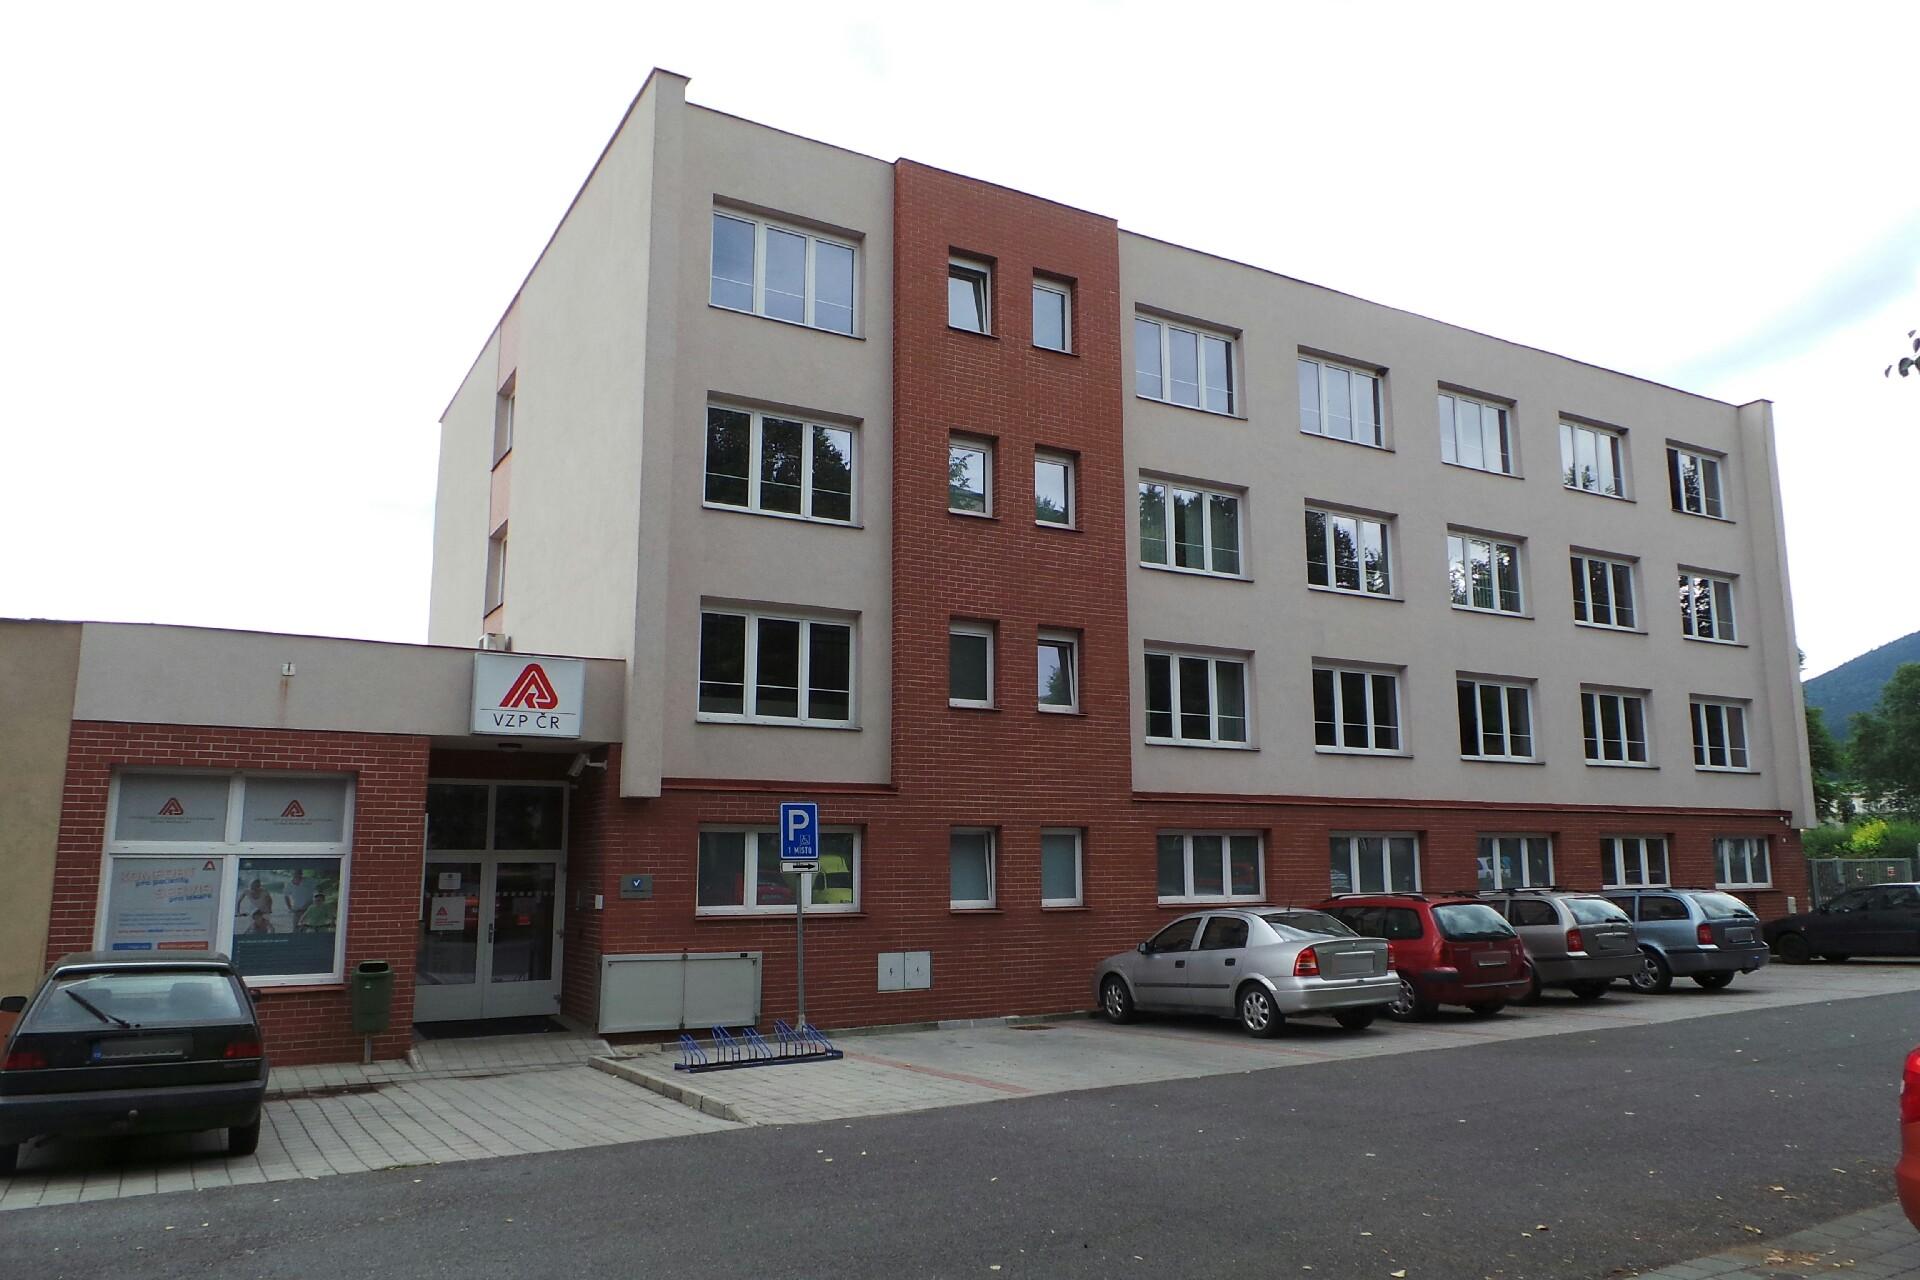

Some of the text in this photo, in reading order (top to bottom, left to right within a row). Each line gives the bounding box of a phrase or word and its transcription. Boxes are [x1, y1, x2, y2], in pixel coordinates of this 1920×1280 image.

[493, 711, 560, 729] VZP ČR
[788, 809, 810, 841] P
